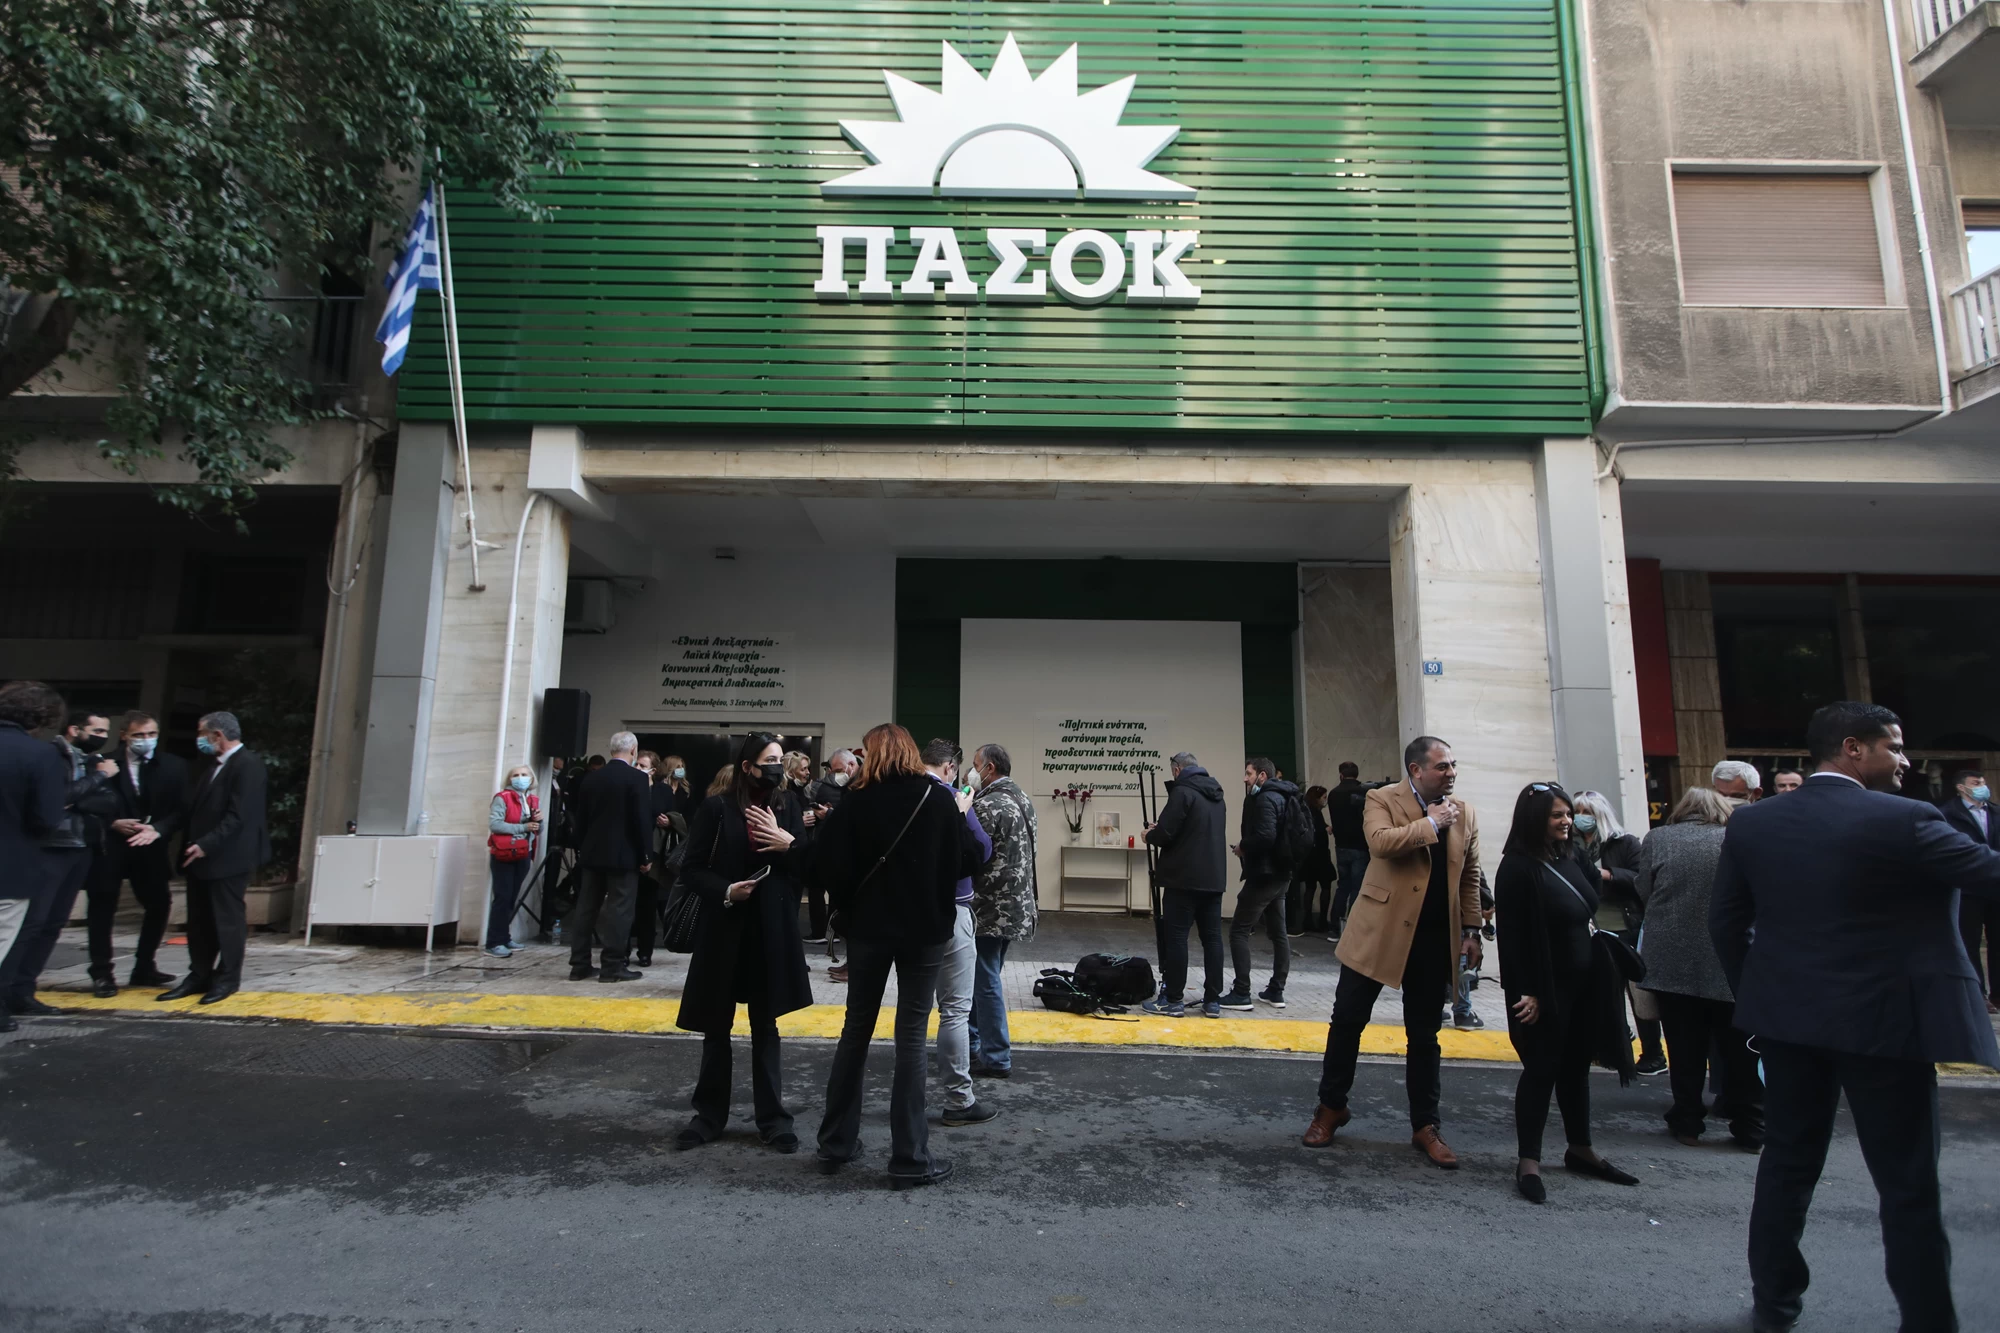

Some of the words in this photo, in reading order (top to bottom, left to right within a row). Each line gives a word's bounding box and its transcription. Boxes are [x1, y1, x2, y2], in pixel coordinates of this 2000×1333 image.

[814, 225, 1201, 305] ΠΑΣΟΚ
[712, 636, 773, 649] Ανεξαρτησία
[682, 650, 710, 660] Λαϊκή
[712, 650, 760, 663] Κυριαρχία
[661, 663, 710, 674] Κοινωνική
[711, 664, 780, 677] Απελευθέρωση
[1428, 663, 1438, 673] 50
[662, 677, 723, 690] Δημοκρατική
[1059, 719, 1104, 732] «Πολιτική
[1105, 719, 1147, 731] ενότητα,
[1061, 733, 1107, 746] αυτόνομη
[1108, 733, 1144, 745] πορεία,
[1045, 746, 1104, 759] προοδευτική
[1106, 747, 1161, 759] ταυτότητα,
[1042, 761, 1128, 774] πρωταγωνιστικός
